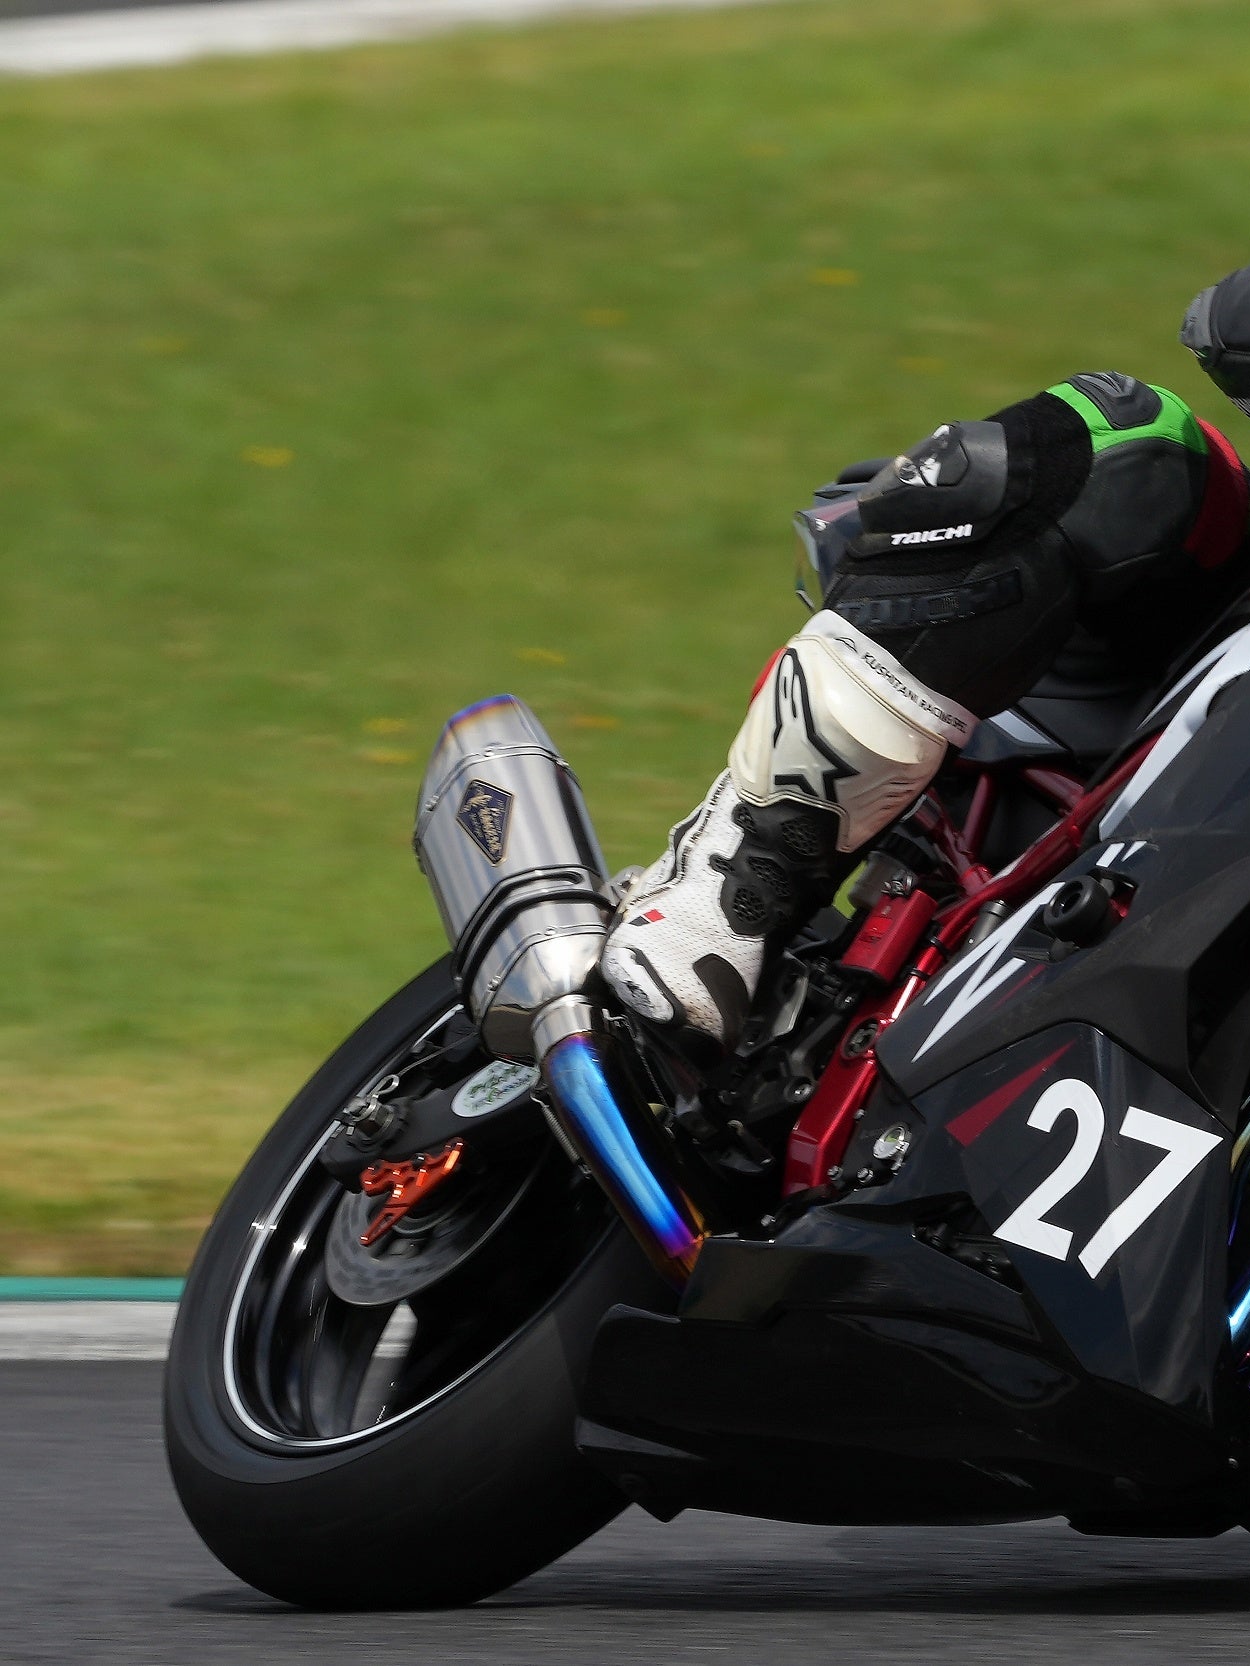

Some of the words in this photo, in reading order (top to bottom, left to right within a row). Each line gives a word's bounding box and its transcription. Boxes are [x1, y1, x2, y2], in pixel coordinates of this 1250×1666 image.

[891, 524, 973, 545] TAICHI
[861, 652, 918, 704] KUSHITANI
[992, 1078, 1224, 1279] 27
